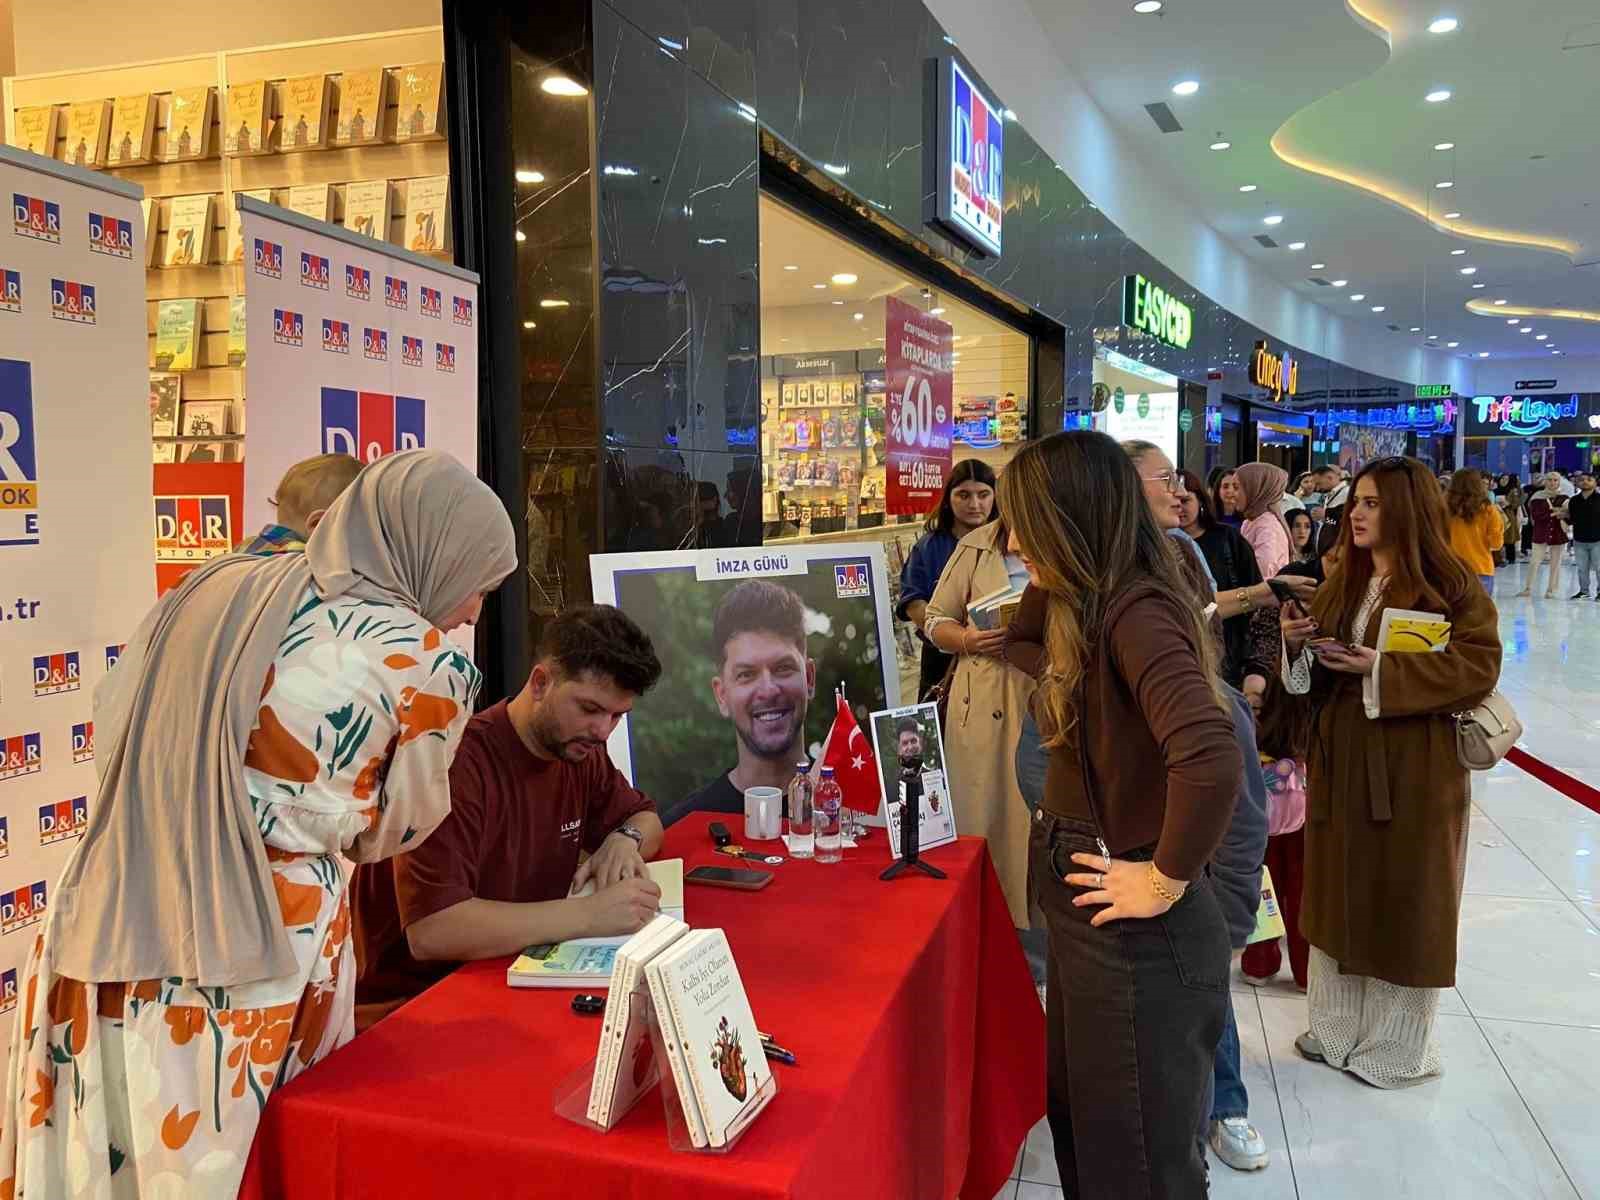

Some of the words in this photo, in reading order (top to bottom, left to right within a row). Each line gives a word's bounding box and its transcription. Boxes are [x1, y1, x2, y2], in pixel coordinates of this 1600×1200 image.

[955, 105, 1001, 202] D&R
[15, 205, 60, 231] D&R
[90, 224, 133, 248] D&R
[53, 290, 96, 313] D&R
[157, 515, 226, 546] D&R
[716, 558, 750, 573] İMZA
[754, 555, 788, 571] GÜNÜ
[36, 662, 79, 684] D&R
[41, 808, 87, 831] D&R
[2, 893, 46, 919] D&R
